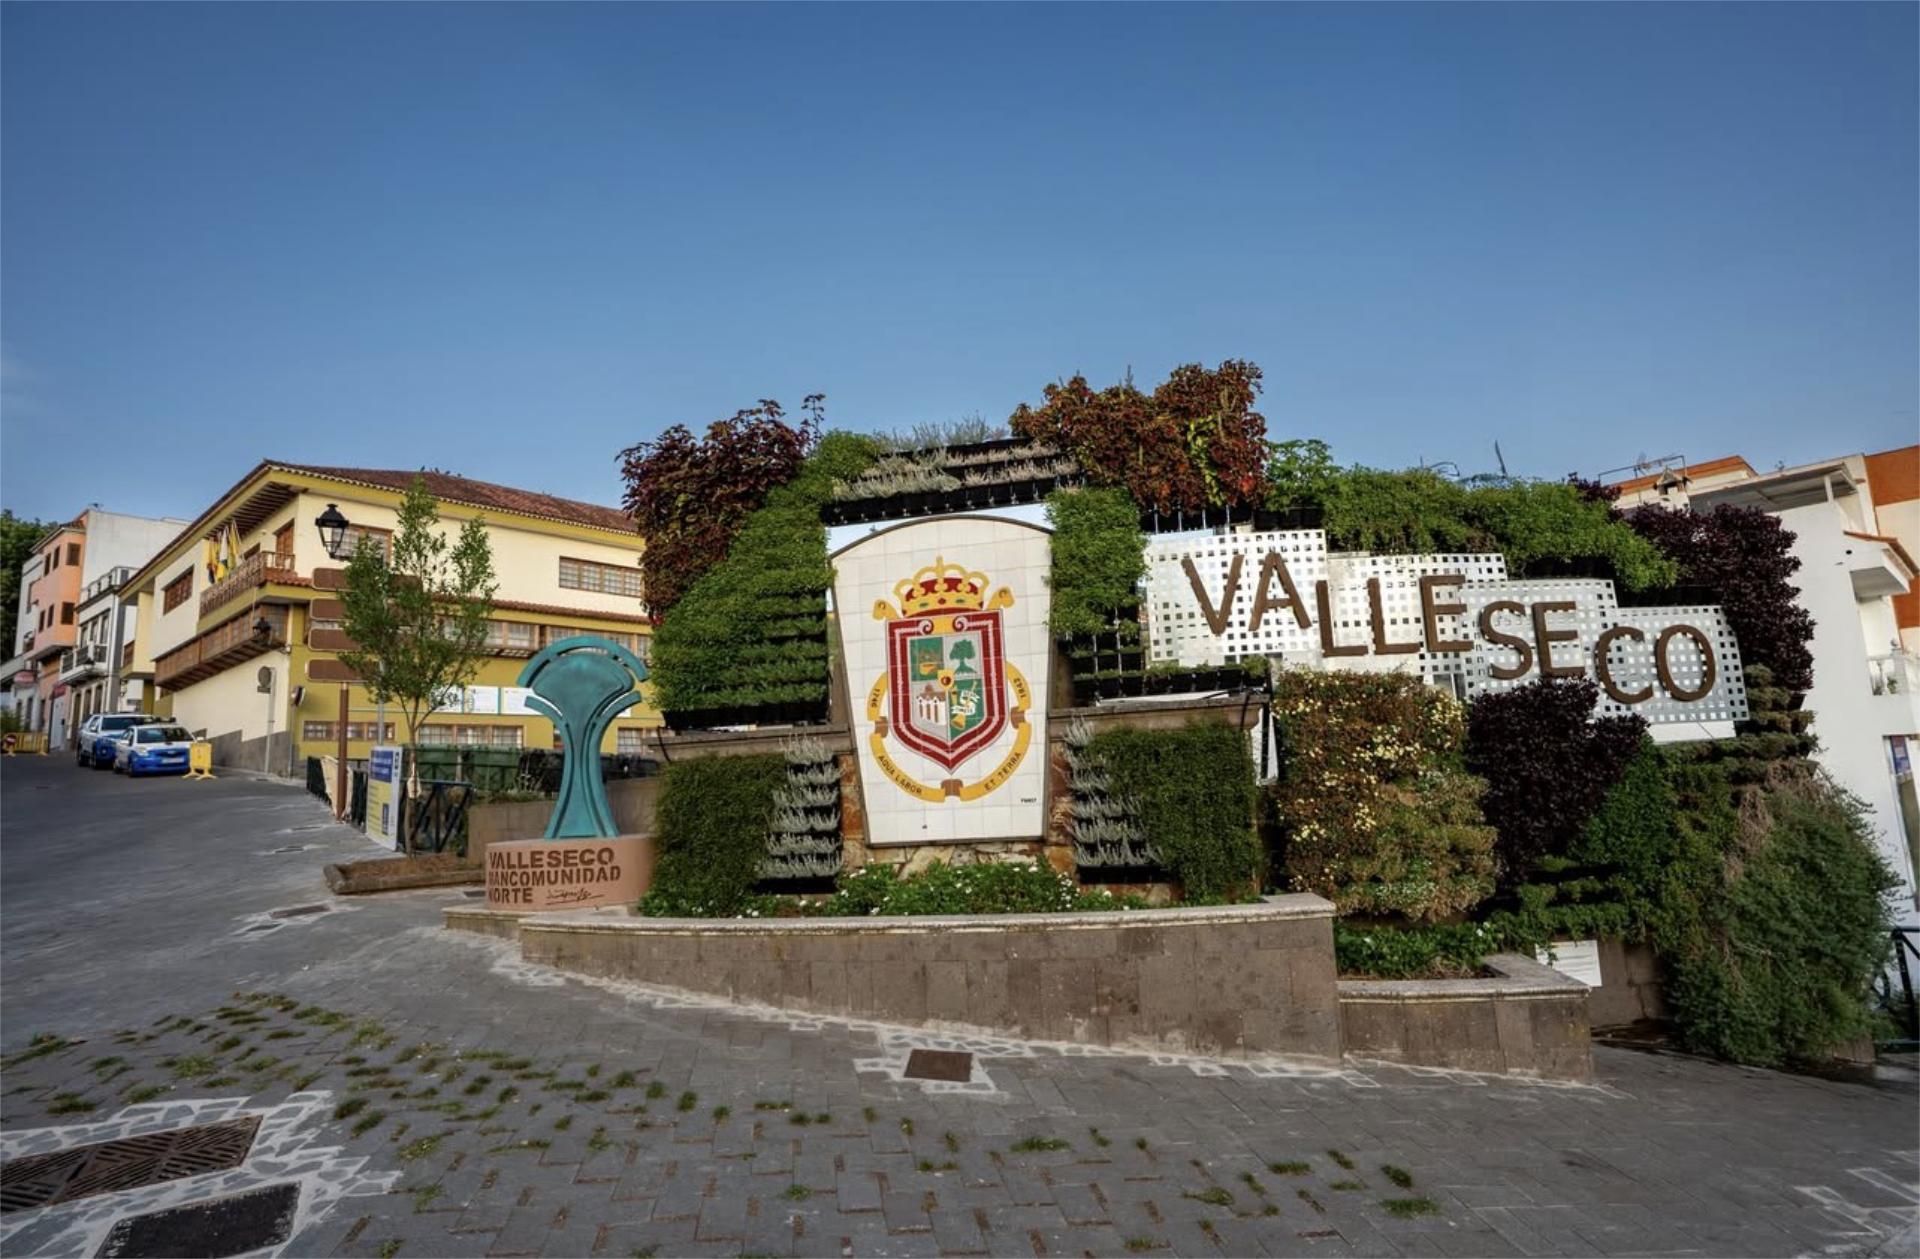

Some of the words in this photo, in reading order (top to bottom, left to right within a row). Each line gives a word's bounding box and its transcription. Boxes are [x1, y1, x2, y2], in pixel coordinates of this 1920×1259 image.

[1181, 551, 1717, 703] VALLESECO
[997, 750, 1021, 778] TERRA
[489, 847, 615, 870] VALLESECO
